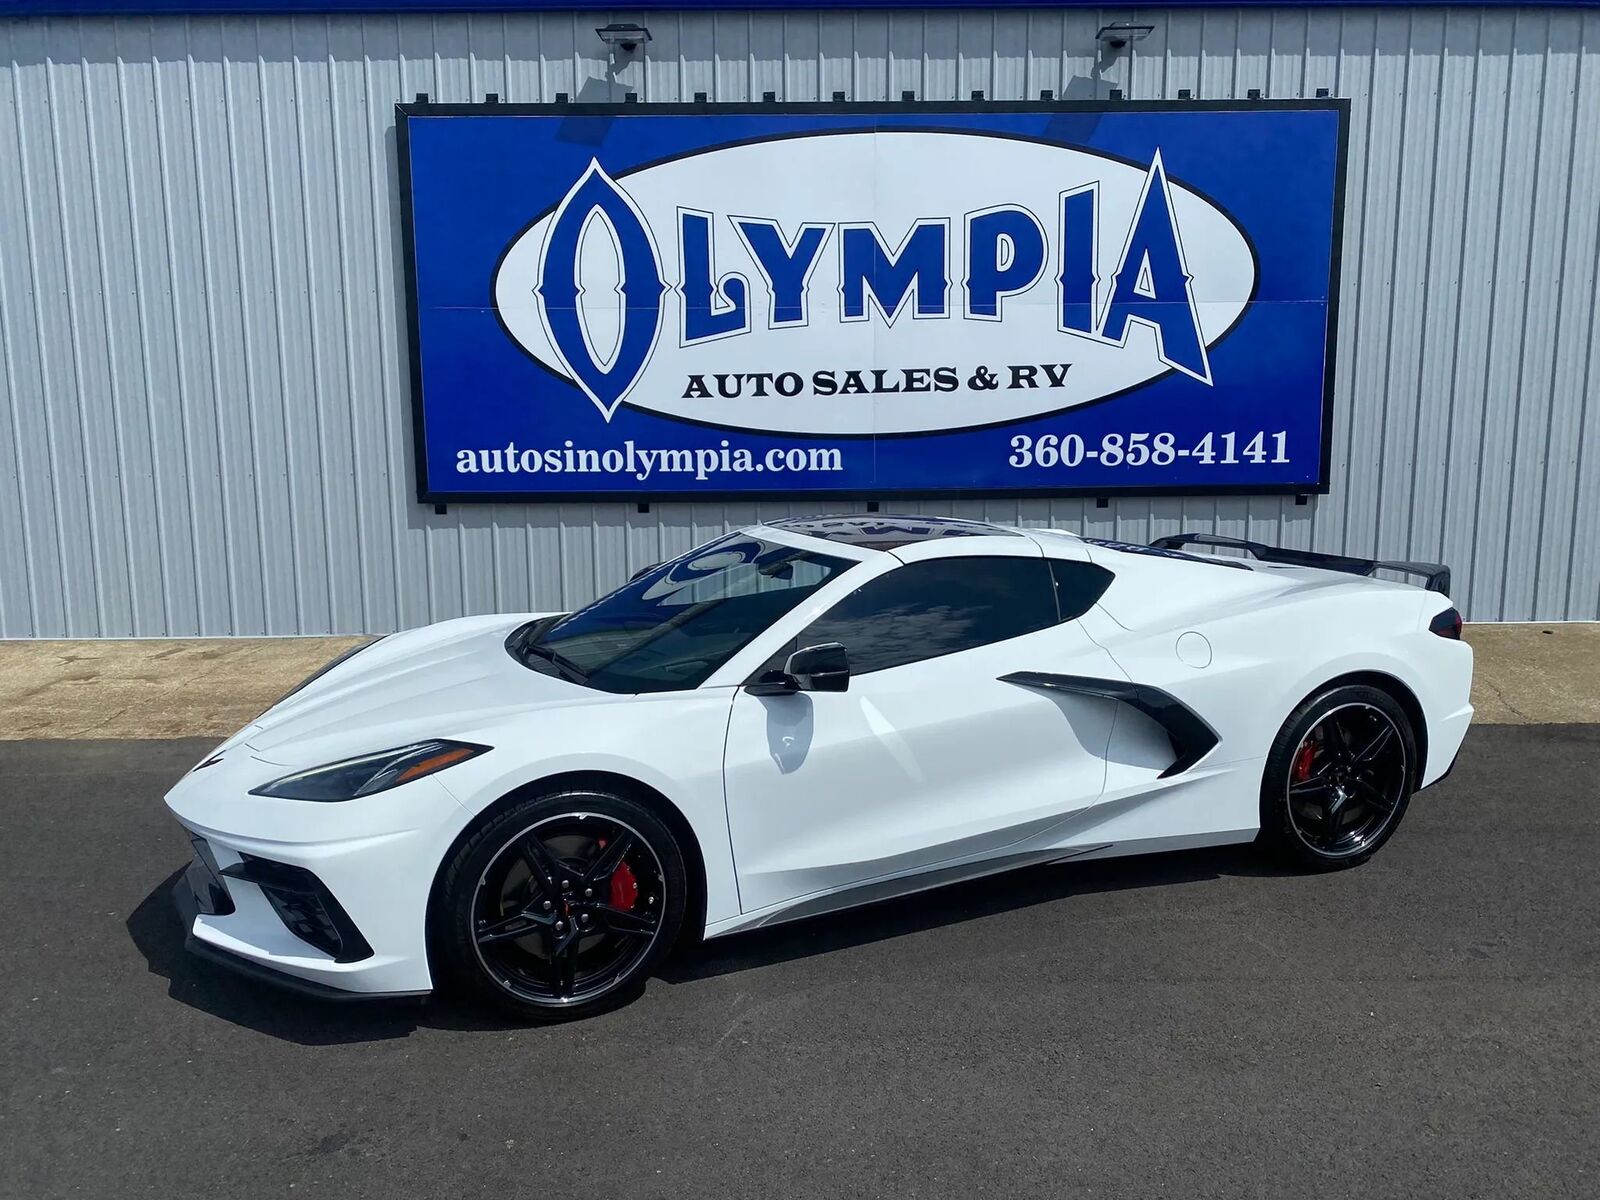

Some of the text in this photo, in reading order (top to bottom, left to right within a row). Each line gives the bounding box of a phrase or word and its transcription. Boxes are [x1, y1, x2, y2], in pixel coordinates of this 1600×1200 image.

[533, 147, 1213, 423] OLYMPIA
[682, 364, 1073, 399] AUTO SALES & RV
[455, 440, 843, 481] autosinolympia.com
[1008, 431, 1291, 468] 360-858-4141
